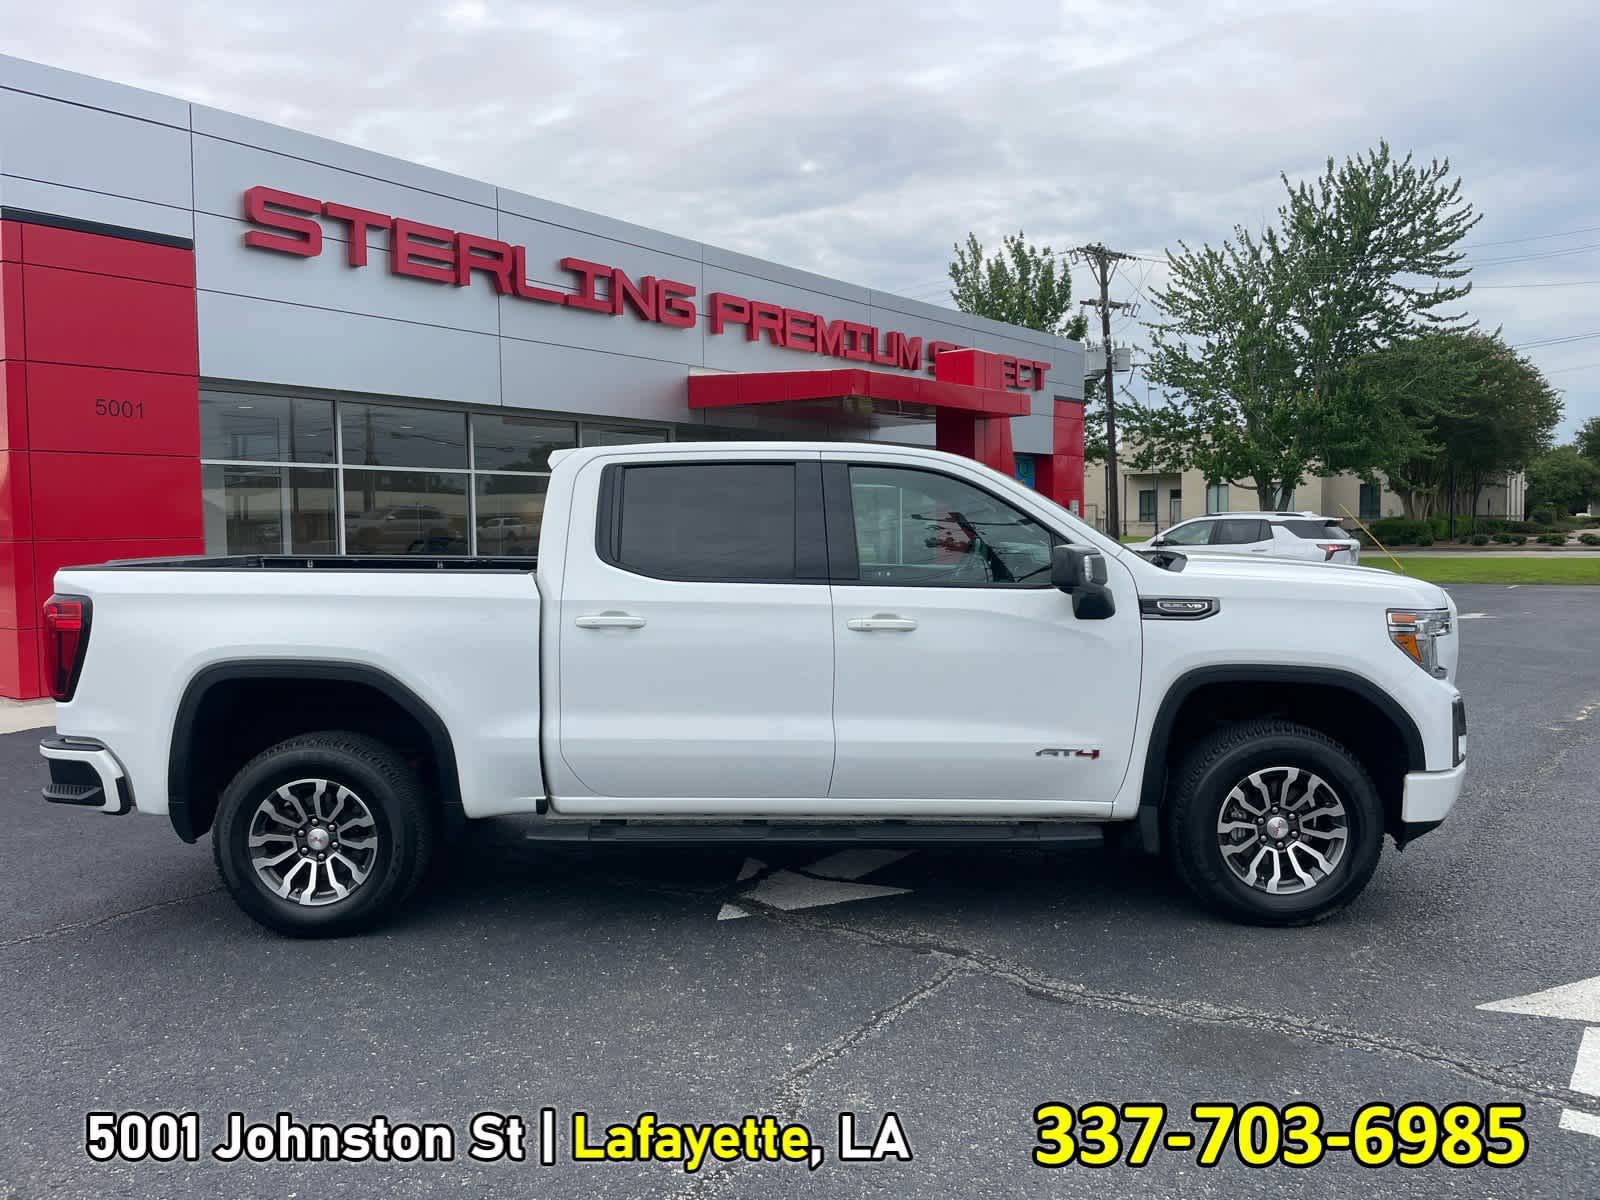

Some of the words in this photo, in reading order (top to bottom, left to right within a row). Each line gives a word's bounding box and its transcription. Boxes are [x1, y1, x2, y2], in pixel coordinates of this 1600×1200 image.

[243, 185, 696, 329] STERLING
[709, 291, 922, 371] PREMIUM
[927, 340, 1051, 392] SECT
[95, 398, 144, 418] 5001
